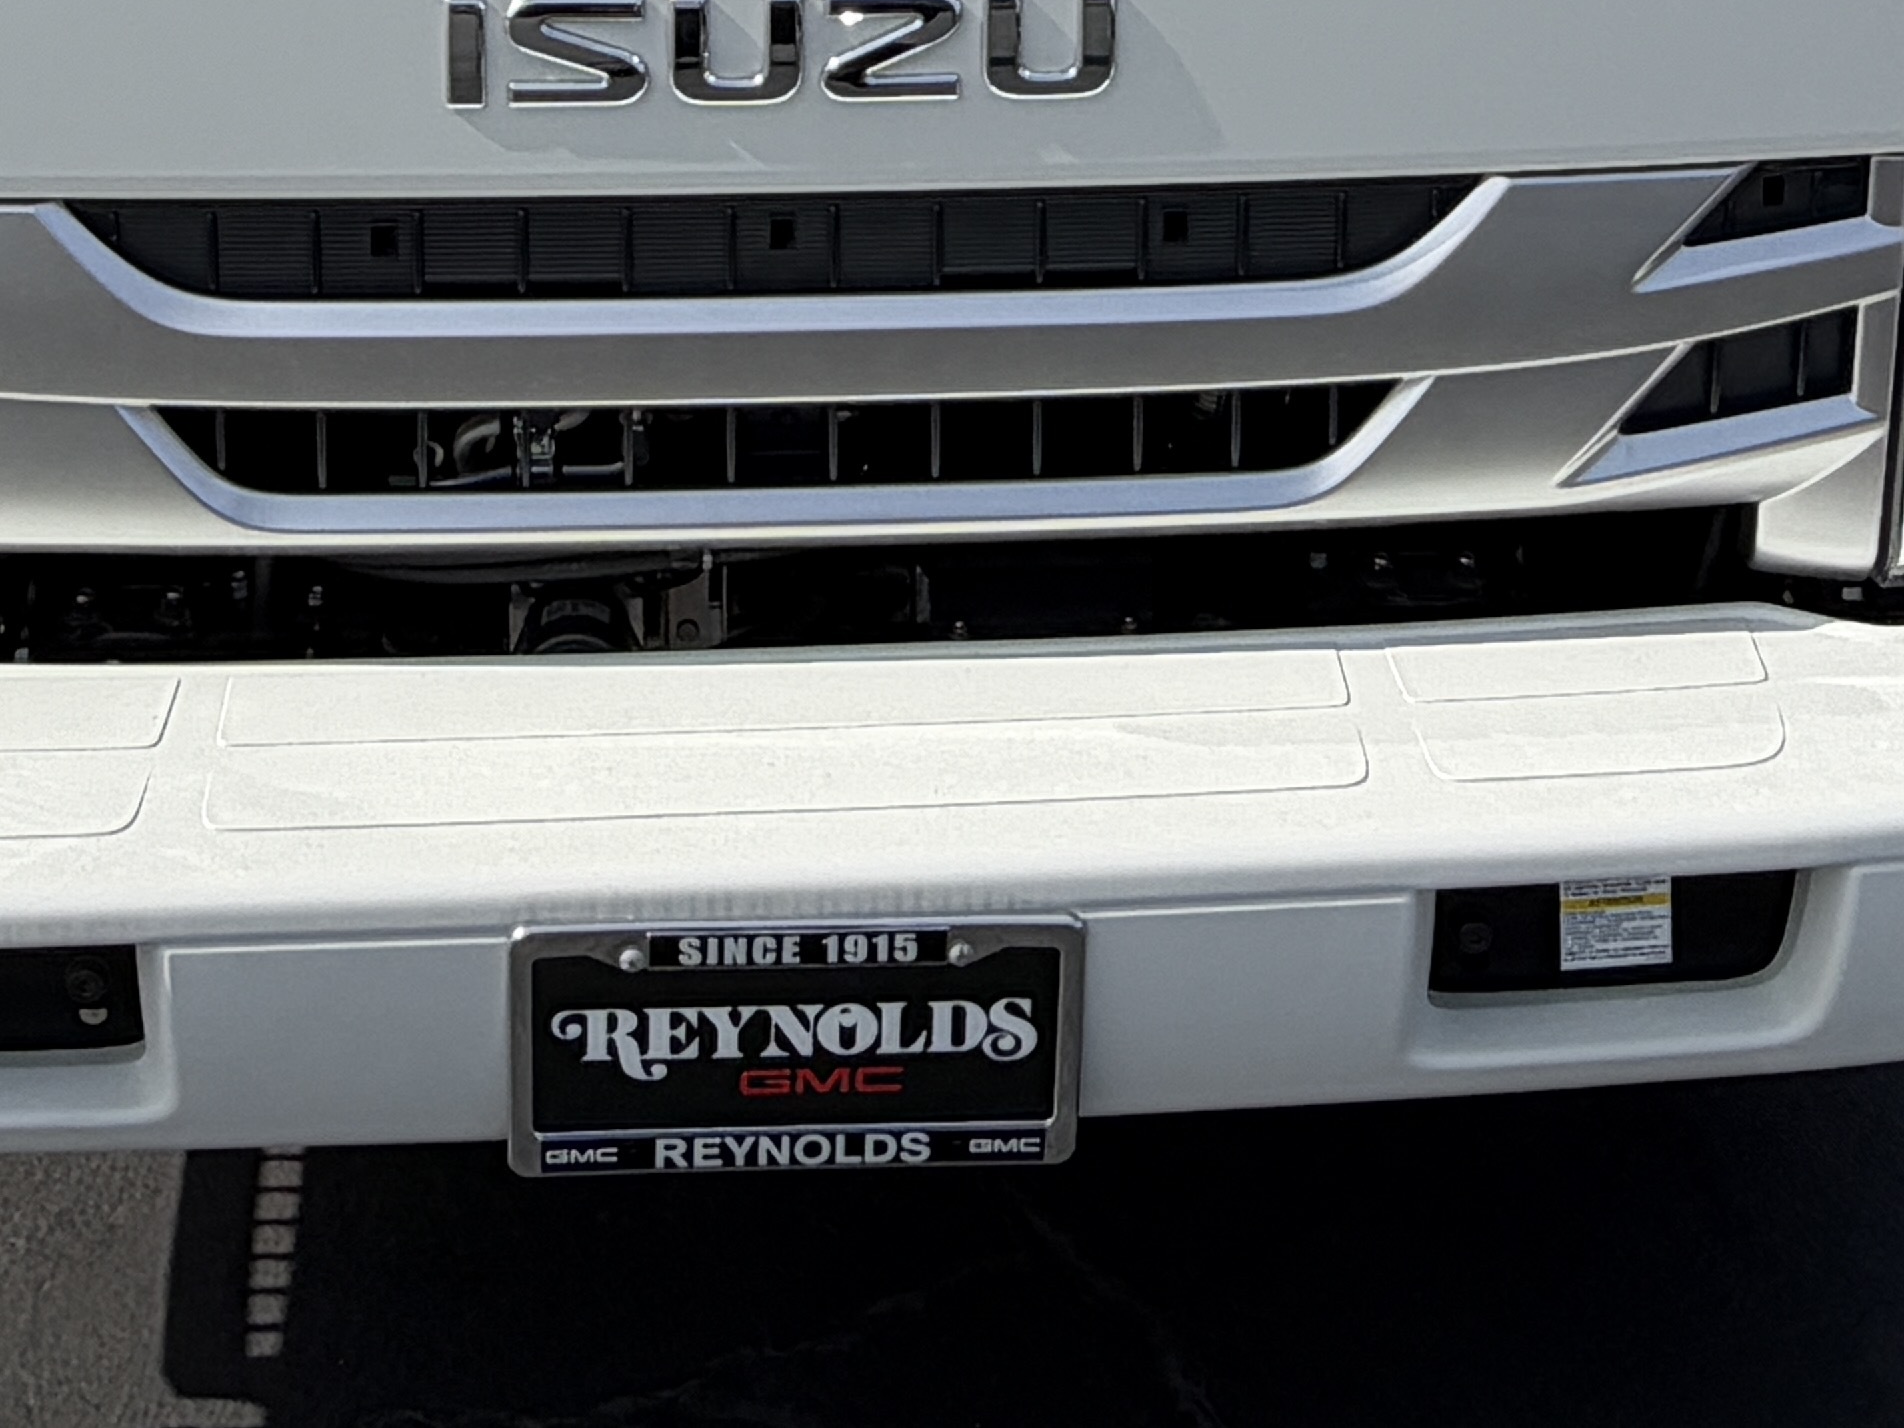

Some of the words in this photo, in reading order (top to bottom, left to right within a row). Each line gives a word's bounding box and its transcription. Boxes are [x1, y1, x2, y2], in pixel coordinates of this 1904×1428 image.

[678, 934, 801, 967] SINCE
[821, 932, 919, 964] 1915
[551, 997, 1039, 1082] REYNOLDS
[739, 1066, 904, 1097] GMC
[545, 1146, 619, 1165] GMC
[654, 1132, 932, 1170] REYNOLDS
[968, 1136, 1042, 1155] GMC
